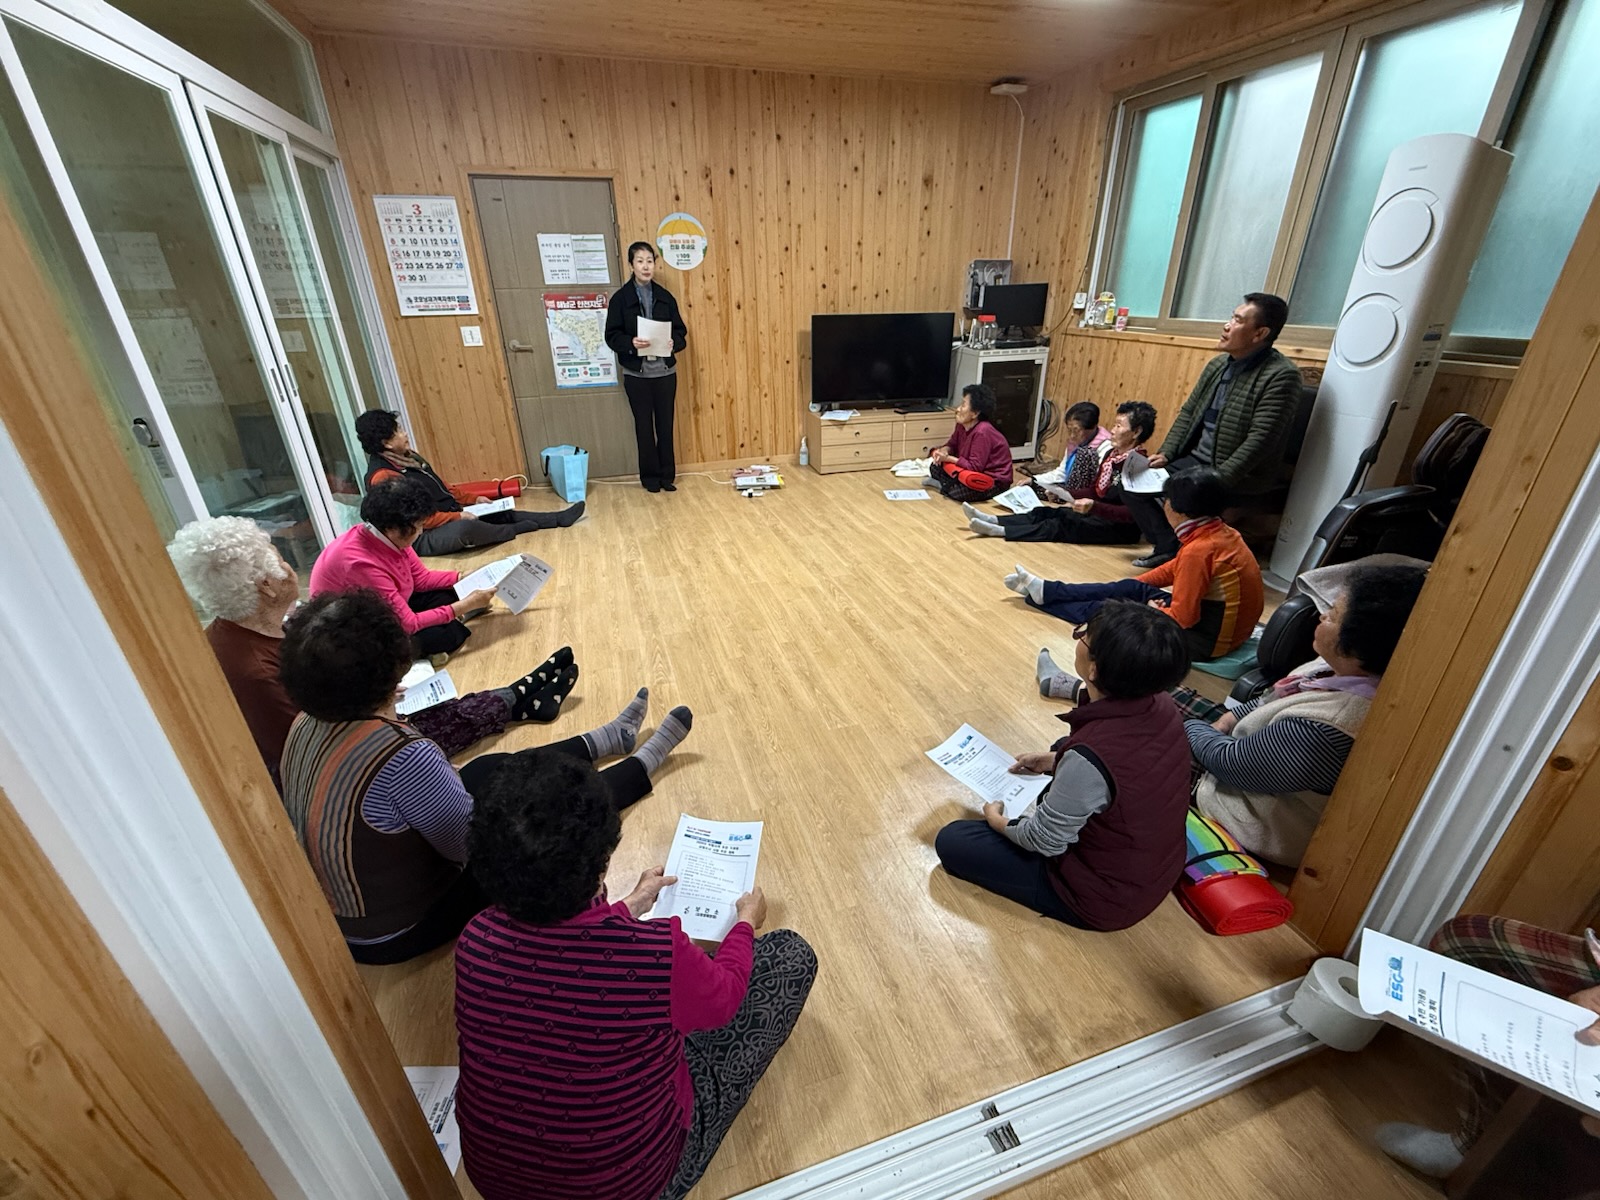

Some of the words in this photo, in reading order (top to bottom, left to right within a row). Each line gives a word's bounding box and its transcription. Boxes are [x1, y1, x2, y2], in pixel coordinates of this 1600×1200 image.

[411, 204, 422, 216] 3
[1391, 974, 1404, 1001] ESG
[1418, 988, 1426, 1006] 기생충
[1429, 999, 1437, 1012] 계획
[1429, 1013, 1438, 1025] 추진
